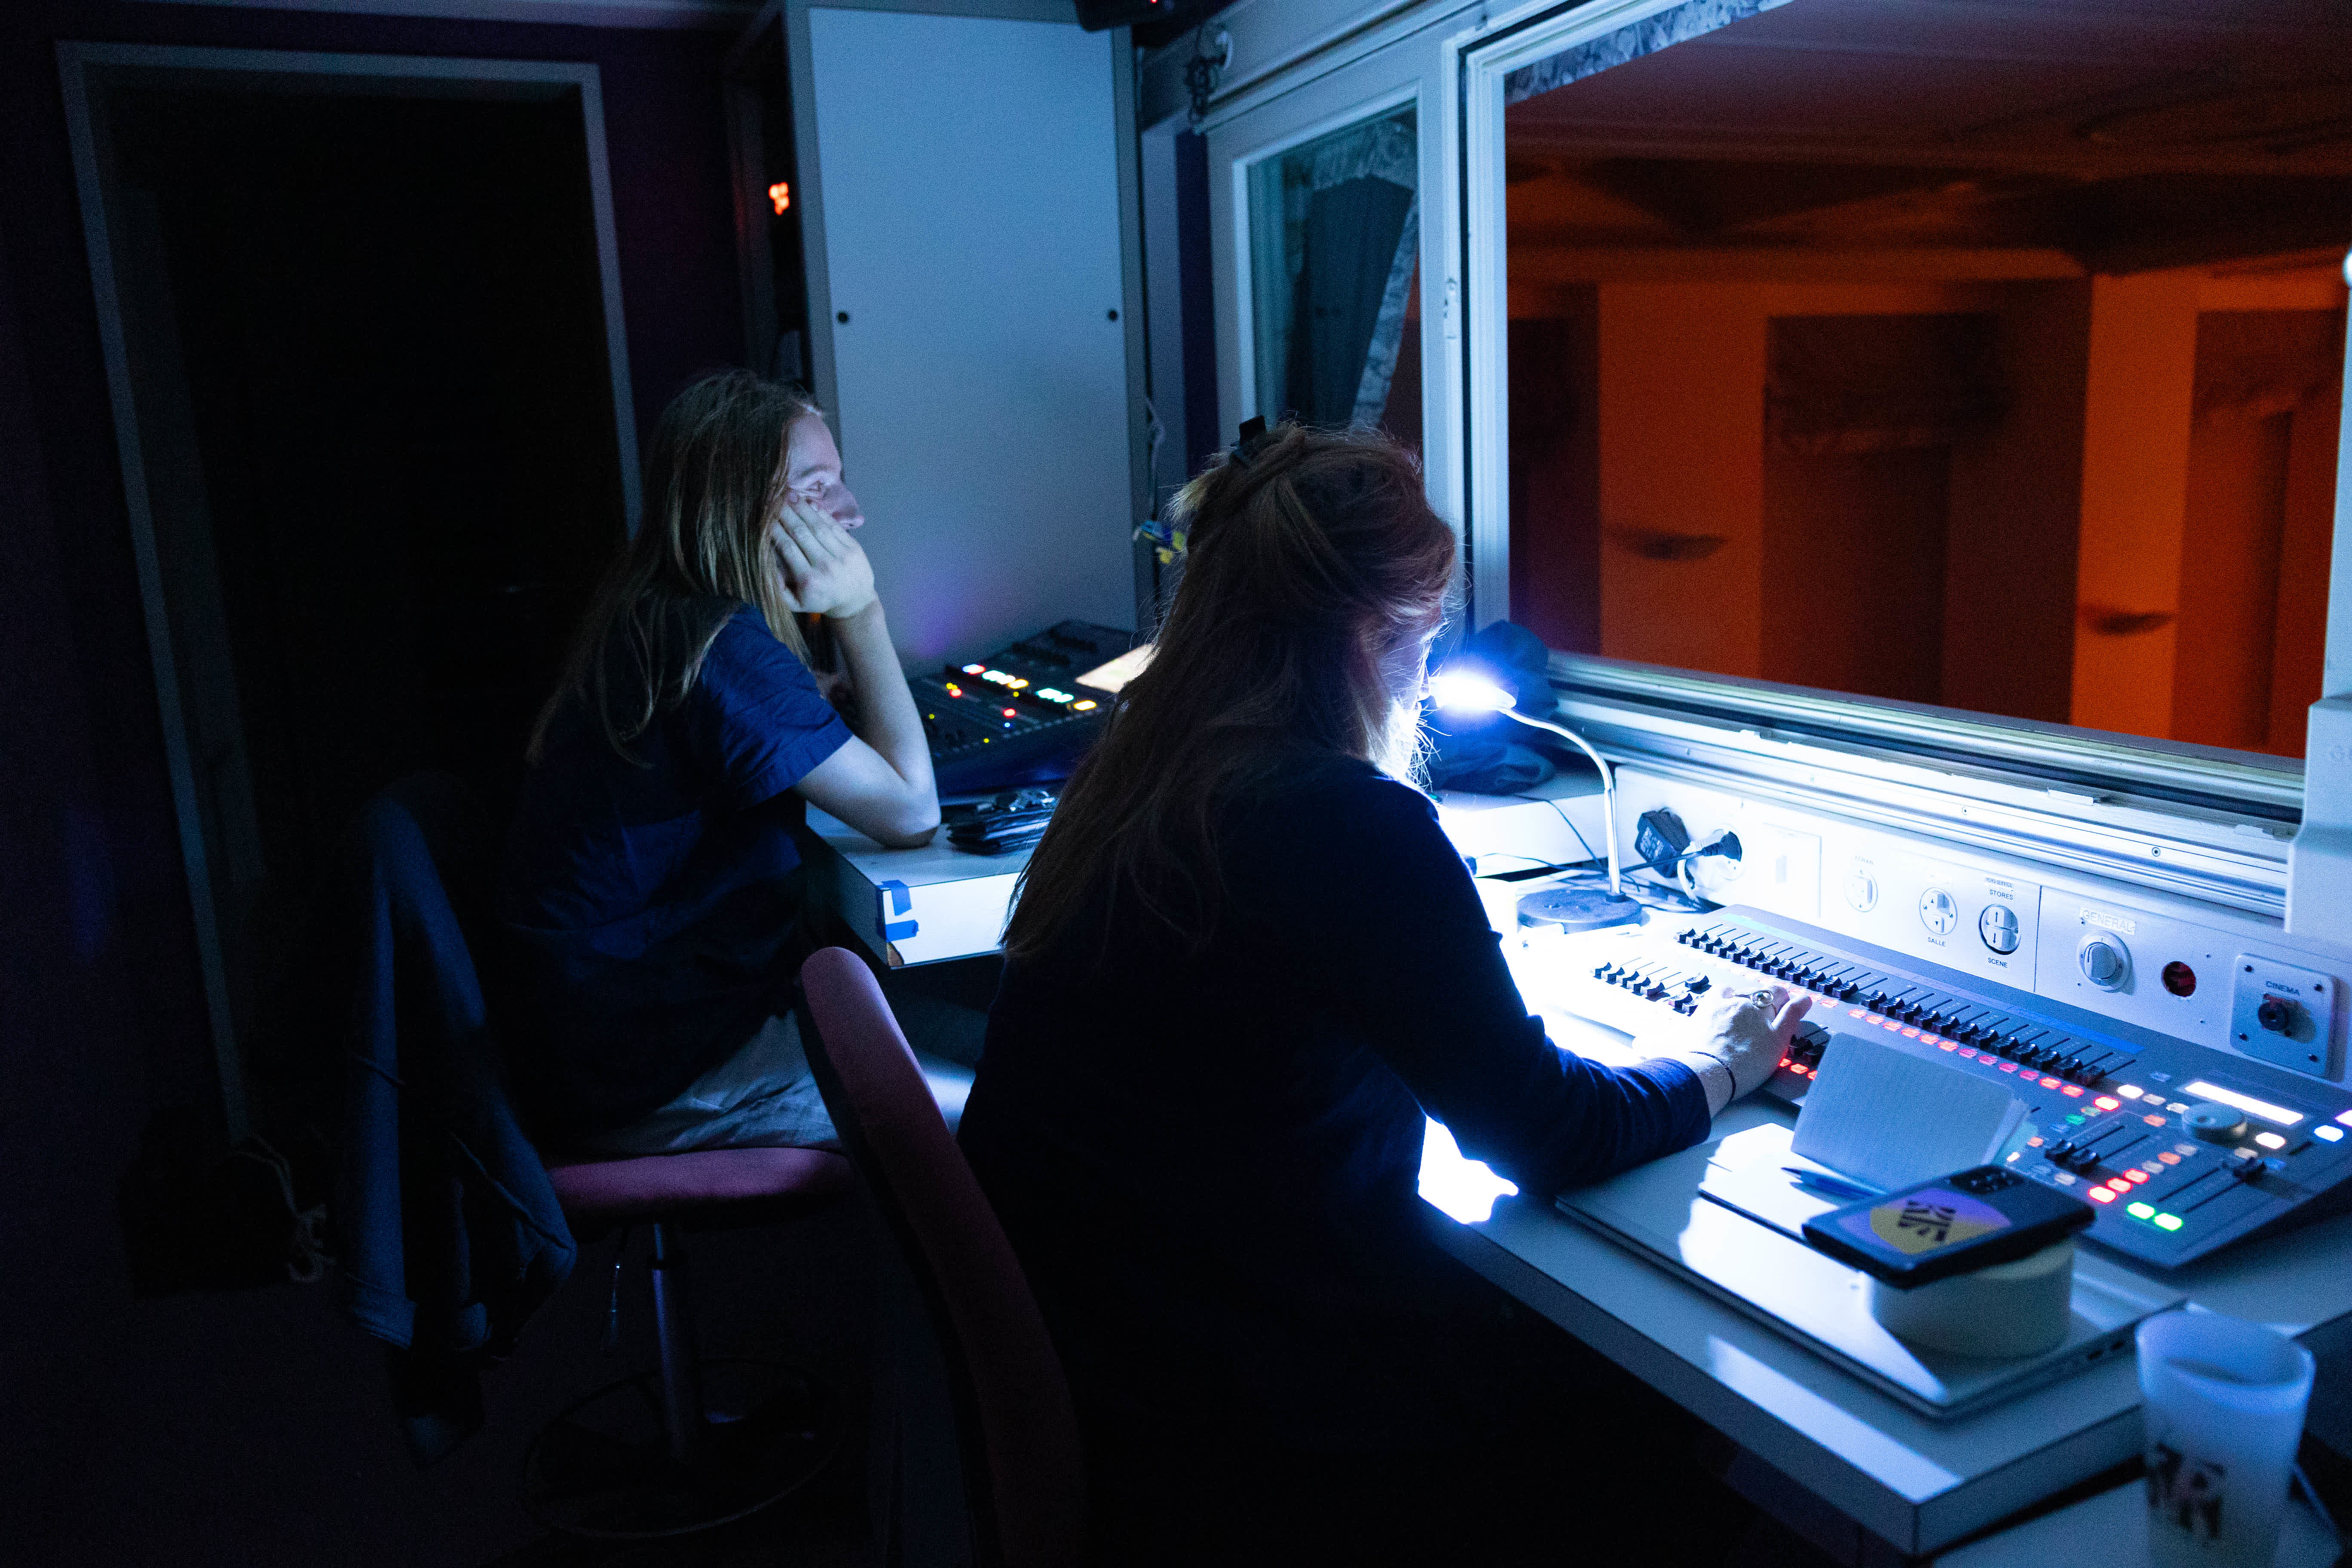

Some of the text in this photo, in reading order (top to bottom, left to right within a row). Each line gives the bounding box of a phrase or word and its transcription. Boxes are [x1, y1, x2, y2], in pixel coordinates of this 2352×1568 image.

[1989, 889, 2013, 900] STORES
[2083, 910, 2133, 932] GENERAL
[1927, 937, 1946, 947] SALLE
[1988, 957, 2008, 968] SCENE
[2266, 980, 2300, 996] CINEMA
